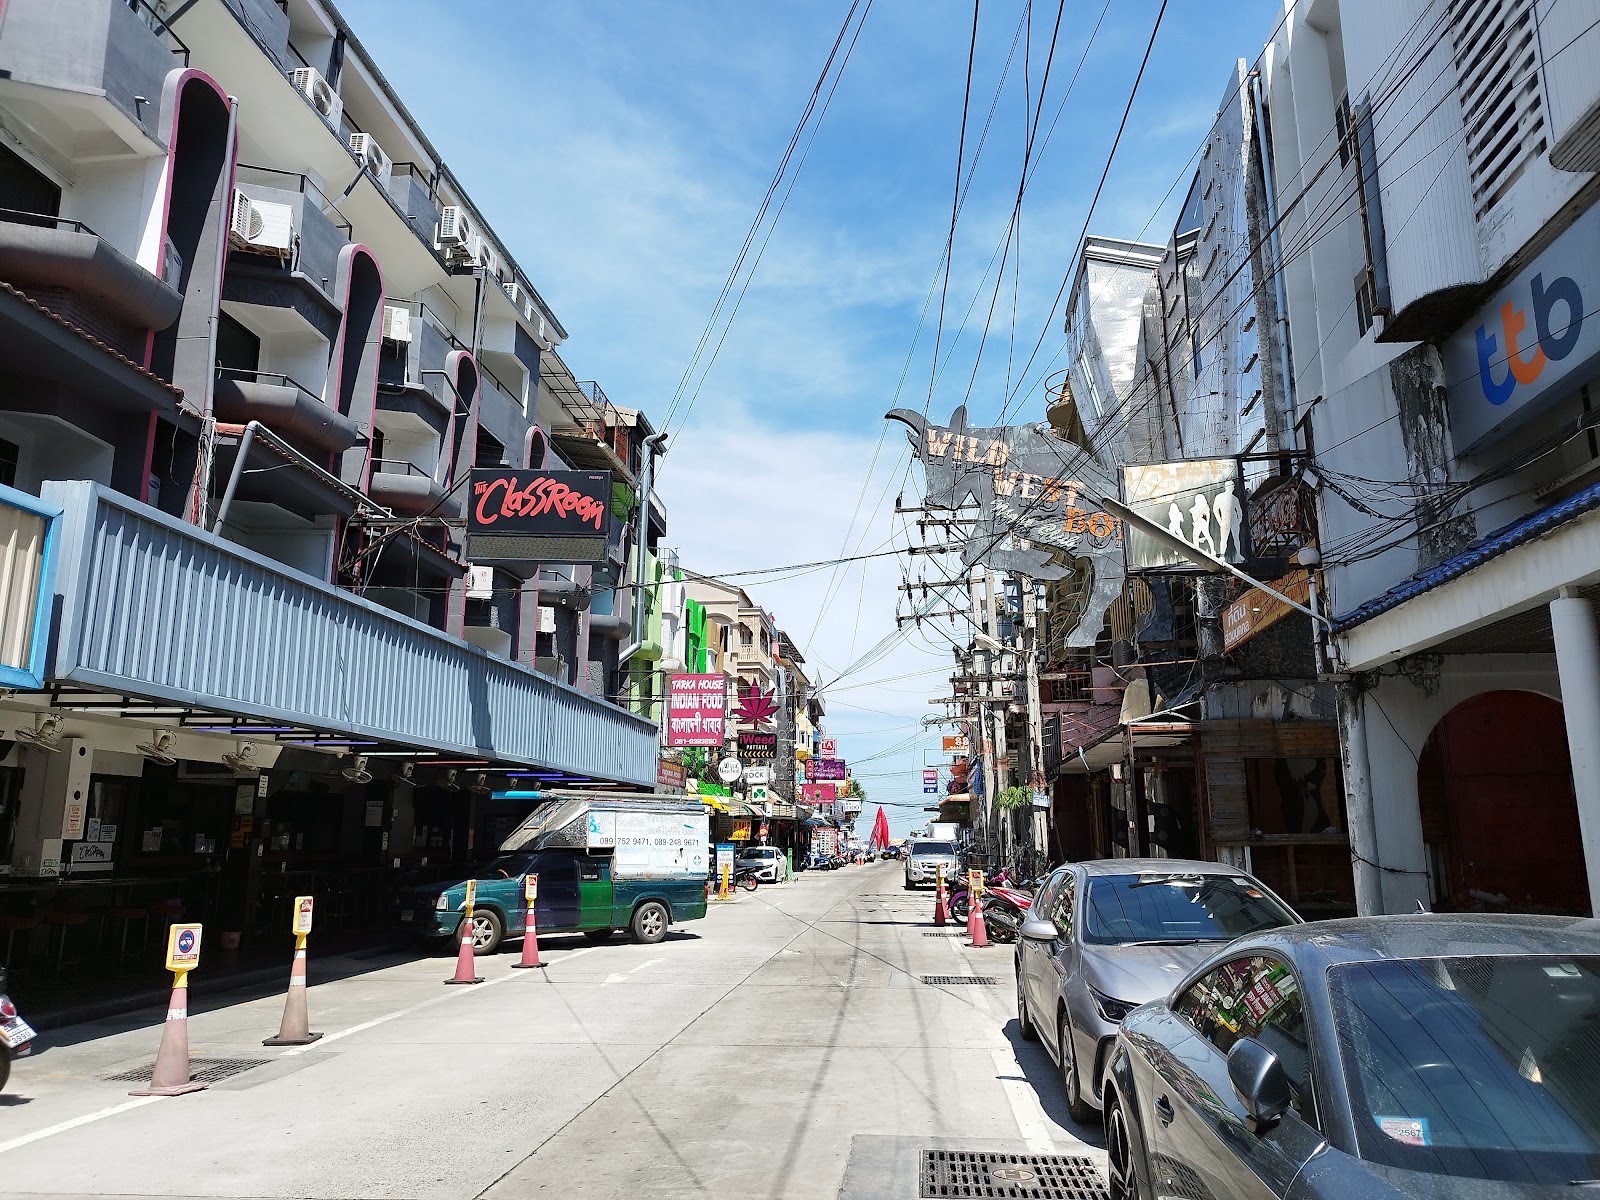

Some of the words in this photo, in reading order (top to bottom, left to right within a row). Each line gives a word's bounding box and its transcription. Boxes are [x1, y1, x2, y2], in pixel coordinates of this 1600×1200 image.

[1475, 272, 1583, 405] ttb
[474, 481, 487, 495] THE
[671, 679, 696, 690] TARKA
[698, 679, 724, 690] HOUSE
[671, 693, 699, 709] INDIAN
[701, 693, 723, 709] FOOD
[739, 734, 775, 745] iWeed
[683, 838, 699, 846] 9671
[11, 1030, 32, 1044] 3990
[1398, 1129, 1421, 1137] 2567
